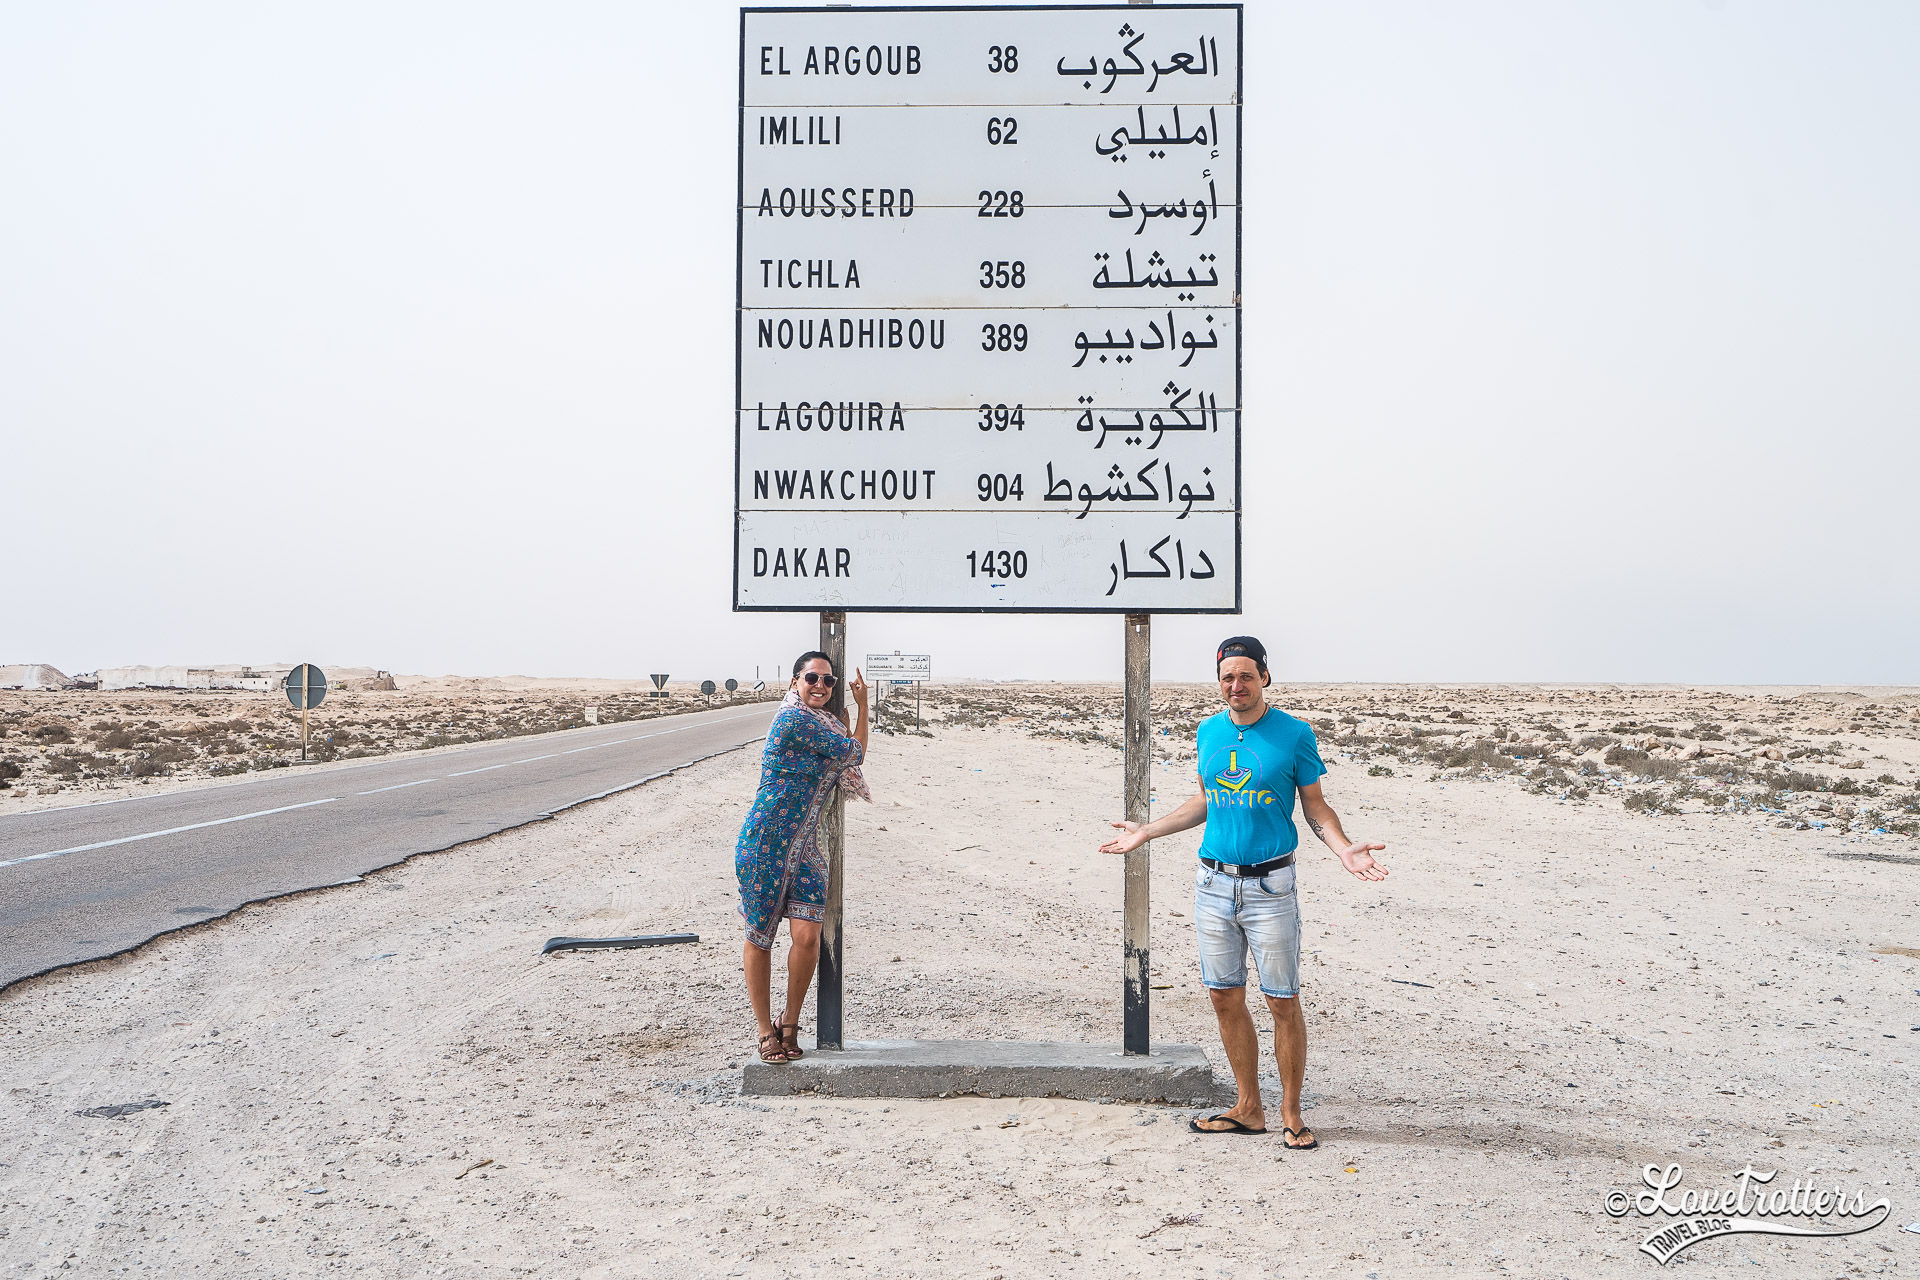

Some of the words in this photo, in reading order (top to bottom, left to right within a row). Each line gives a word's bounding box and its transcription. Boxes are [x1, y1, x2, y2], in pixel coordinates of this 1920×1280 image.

[761, 46, 790, 75] EL
[804, 46, 922, 75] ARGOUB
[988, 45, 1018, 73] 38
[760, 116, 841, 145] IMLILI
[987, 117, 1018, 145] 62
[758, 188, 914, 218] AOUSSERD
[977, 191, 1024, 218] 228
[1109, 169, 1219, 235] أوسرد
[760, 260, 861, 289] TICHLA
[979, 261, 1026, 289] 358
[1092, 248, 1219, 301] تيشلة
[758, 318, 945, 349] NOUADHIBOU
[981, 323, 1028, 352] 389
[1072, 310, 1218, 367] نواديبو
[757, 401, 905, 431] LAGOUIRA
[978, 404, 1025, 431] 394
[754, 470, 936, 500] NWAKCHOUT
[977, 474, 1024, 501] 904
[1044, 458, 1215, 519] نواكشوط
[753, 547, 851, 578] DAKAR
[966, 550, 1028, 579] 1430
[1105, 535, 1215, 595] داكار
